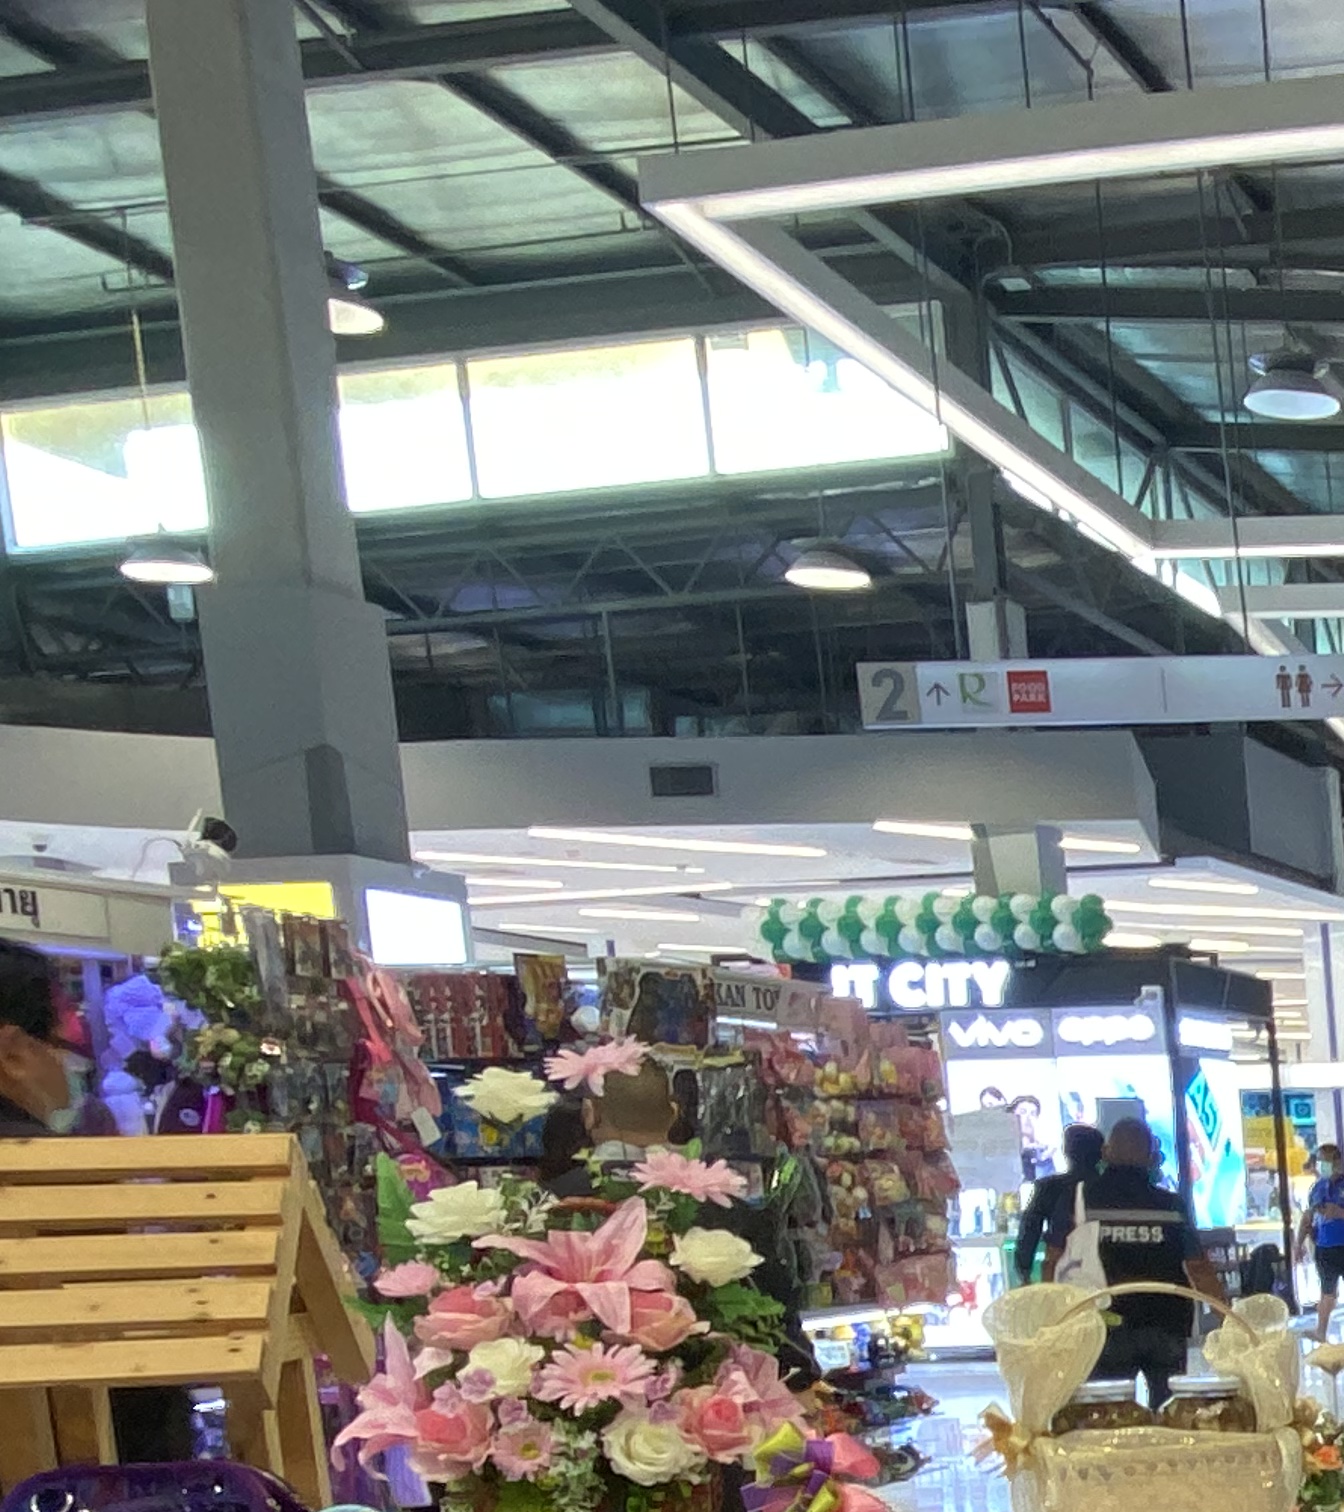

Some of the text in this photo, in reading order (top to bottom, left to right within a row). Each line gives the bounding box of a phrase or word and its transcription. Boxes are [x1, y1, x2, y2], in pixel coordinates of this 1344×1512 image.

[871, 668, 910, 721] 2
[831, 959, 1011, 1010] IT CITY
[1101, 1225, 1164, 1243] PRESS
